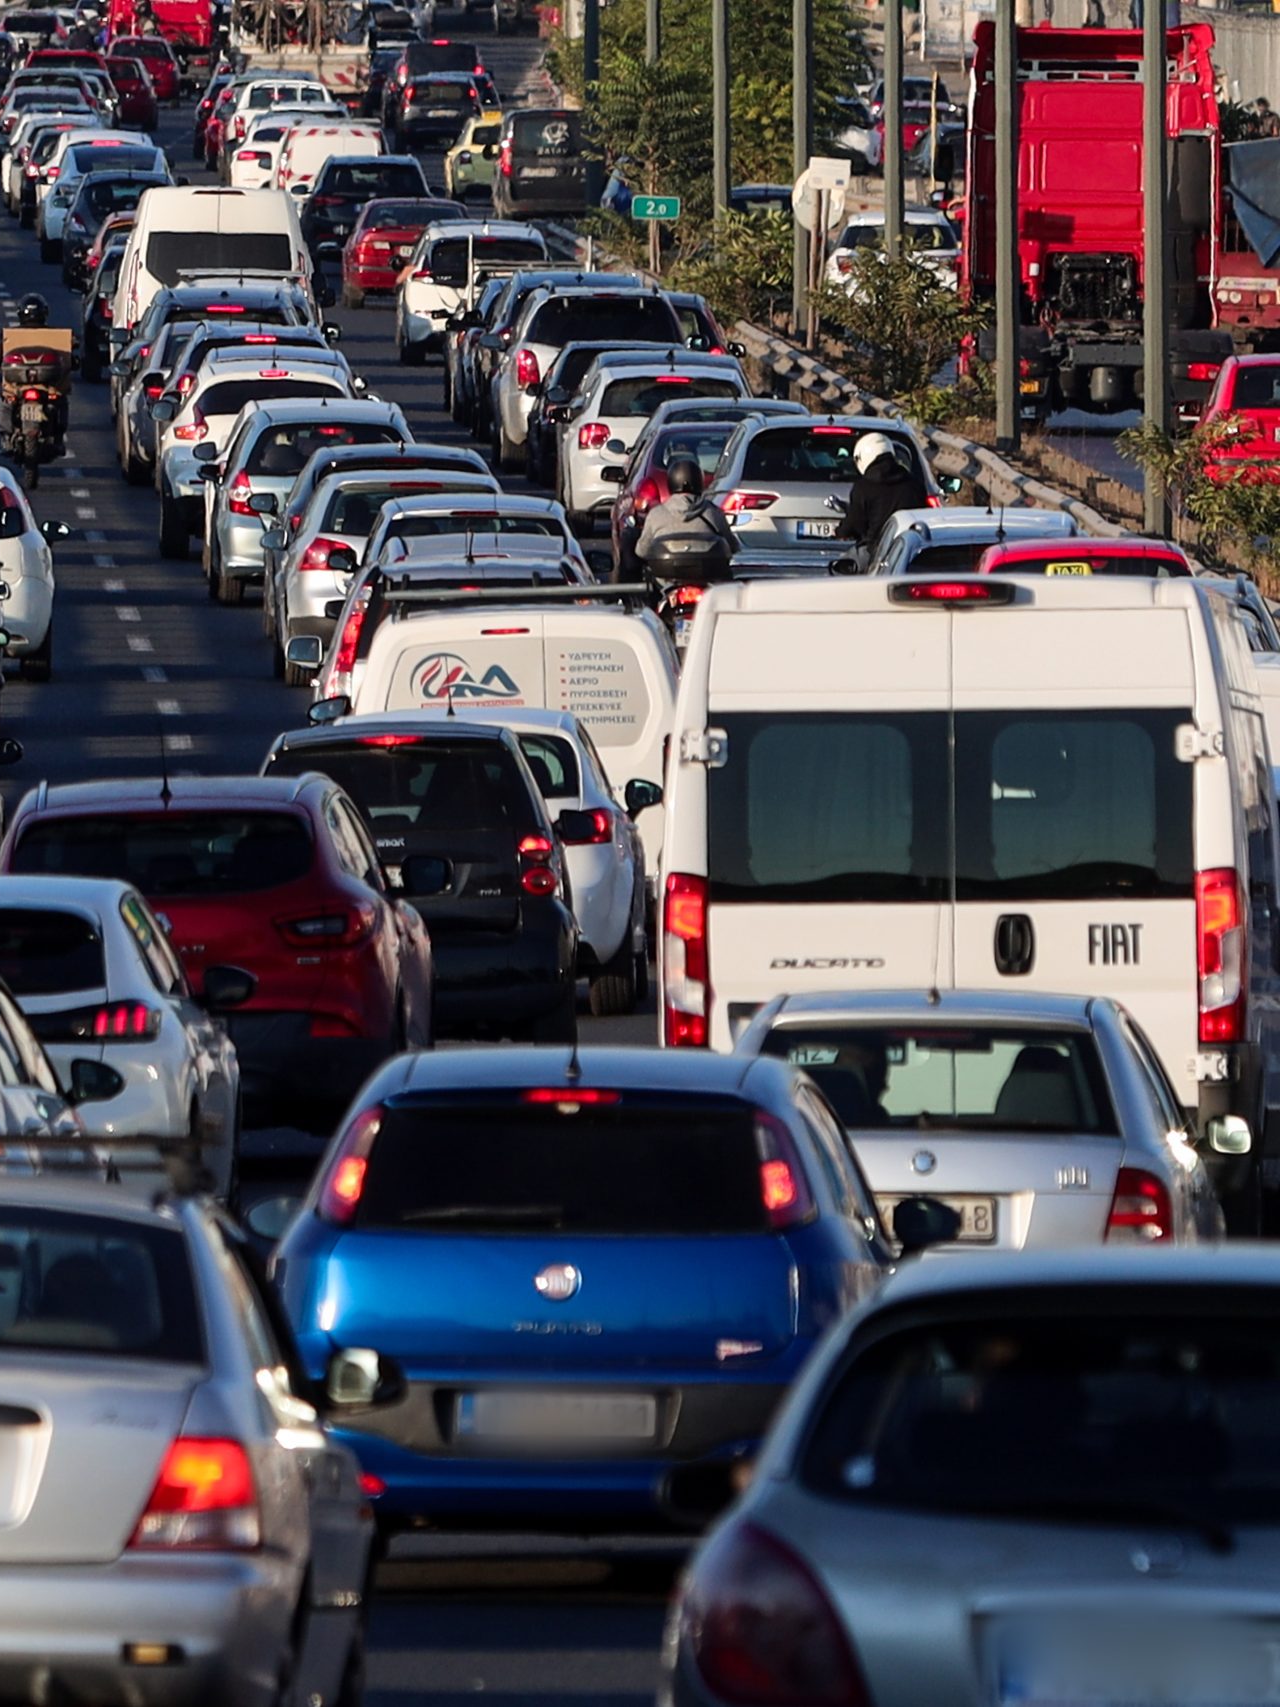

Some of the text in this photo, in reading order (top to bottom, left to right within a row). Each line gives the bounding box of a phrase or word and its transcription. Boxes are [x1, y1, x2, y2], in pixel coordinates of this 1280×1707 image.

[1055, 566, 1084, 577] TAXI
[1088, 923, 1143, 965] FIAT
[769, 957, 886, 970] DUCATO
